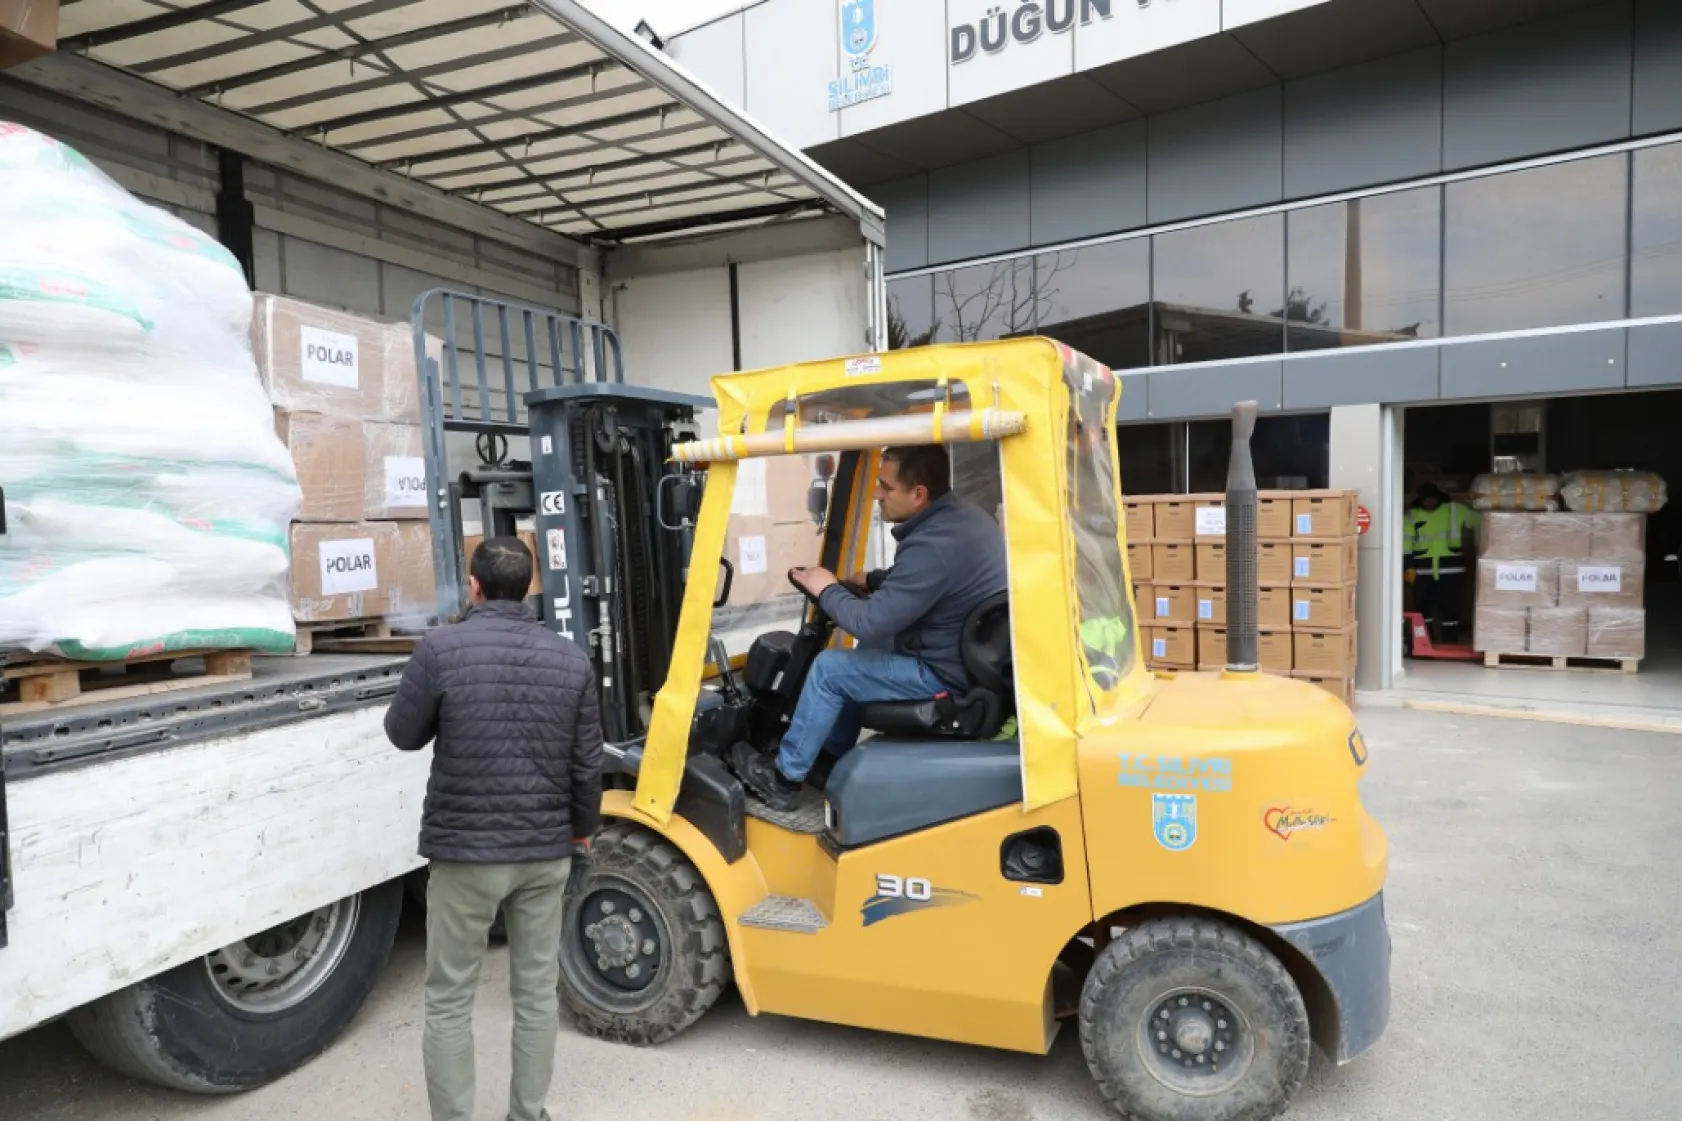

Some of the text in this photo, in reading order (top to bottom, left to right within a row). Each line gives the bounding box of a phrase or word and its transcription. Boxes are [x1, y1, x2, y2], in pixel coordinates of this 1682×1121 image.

[306, 344, 354, 367] POLAR
[326, 553, 372, 574] POLAR
[876, 873, 932, 901] 30
